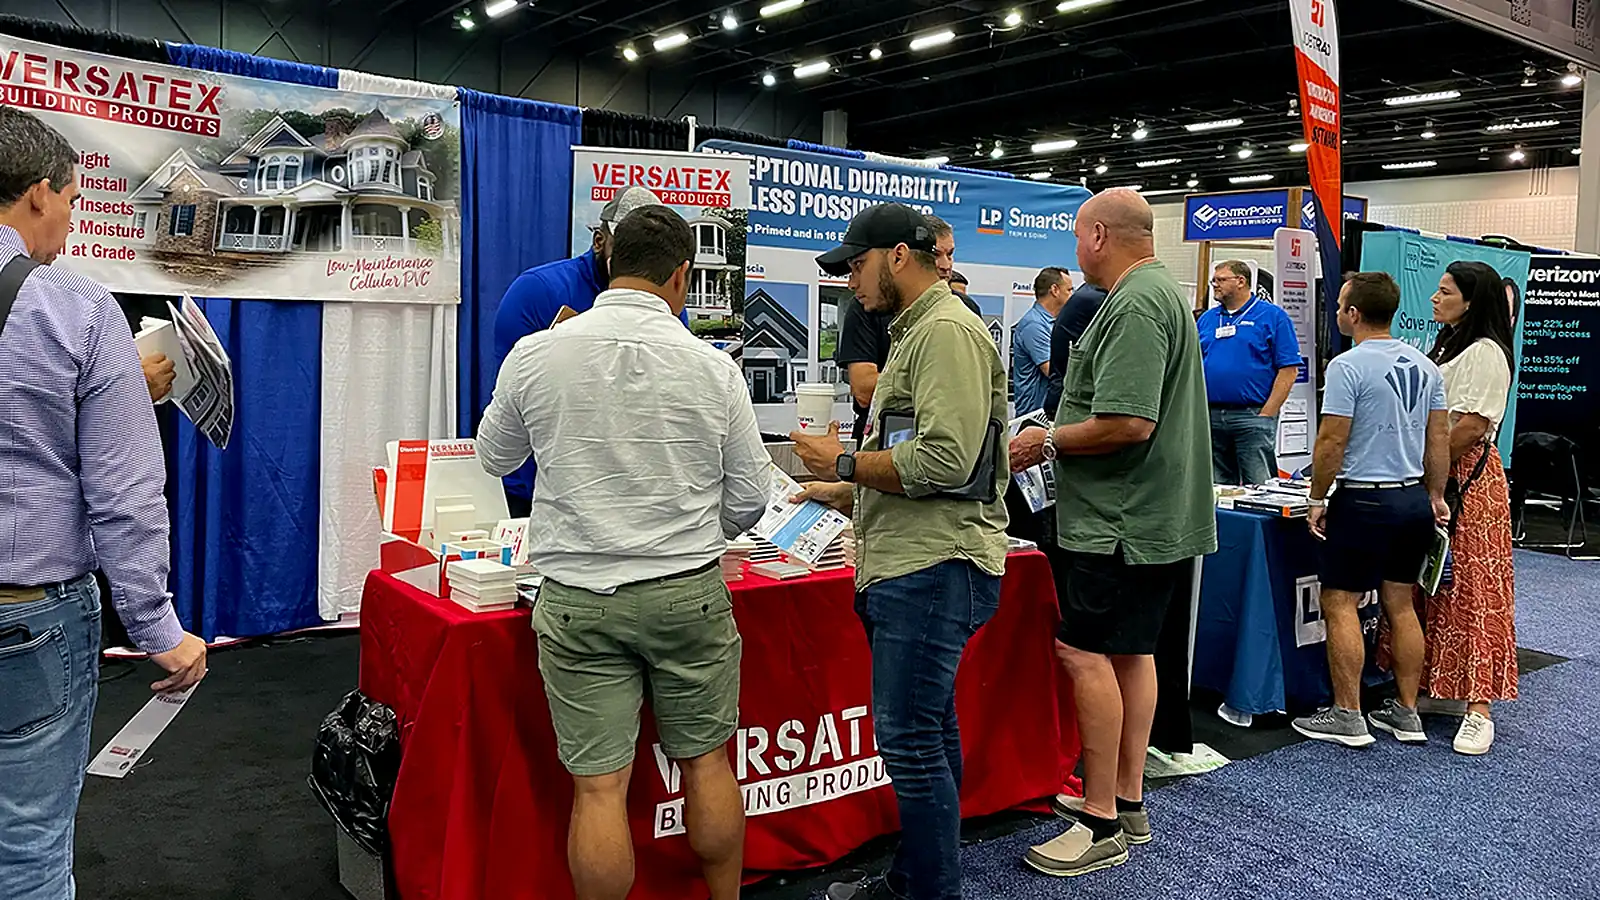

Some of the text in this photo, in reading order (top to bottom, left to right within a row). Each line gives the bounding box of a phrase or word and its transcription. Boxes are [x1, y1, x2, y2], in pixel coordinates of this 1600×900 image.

[108, 103, 218, 135] PRODUCTS
[80, 150, 110, 169] ight
[80, 173, 127, 192] Install
[592, 163, 731, 192] VERSATEX
[847, 167, 961, 204] DURABILITY.
[80, 196, 135, 216] Insects
[661, 191, 730, 206] PRODUCTS
[748, 185, 796, 215] LESS
[79, 219, 145, 239] Moisture
[980, 207, 1076, 232] LP SmartSi
[754, 223, 791, 237] Primed
[793, 229, 812, 239] and
[813, 229, 824, 240] in
[825, 231, 836, 241] 16
[71, 243, 87, 256] at
[91, 243, 136, 261] Grade
[326, 255, 434, 276] Low-Maintenance
[747, 263, 765, 273] scia
[349, 269, 430, 291] Cellular PVC
[1013, 282, 1032, 291] Panel
[1525, 289, 1600, 299] et America's Most
[1525, 297, 1553, 306] eliable
[1399, 311, 1425, 331] Save
[1543, 319, 1564, 329] 22%
[1565, 320, 1580, 329] off
[1532, 356, 1542, 364] to
[1543, 355, 1564, 365] 35%
[1565, 356, 1580, 365] off
[1537, 383, 1587, 393] employees
[430, 443, 474, 452] VERSATEX
[652, 705, 878, 795] VRSAT
[805, 758, 886, 800] PRODU
